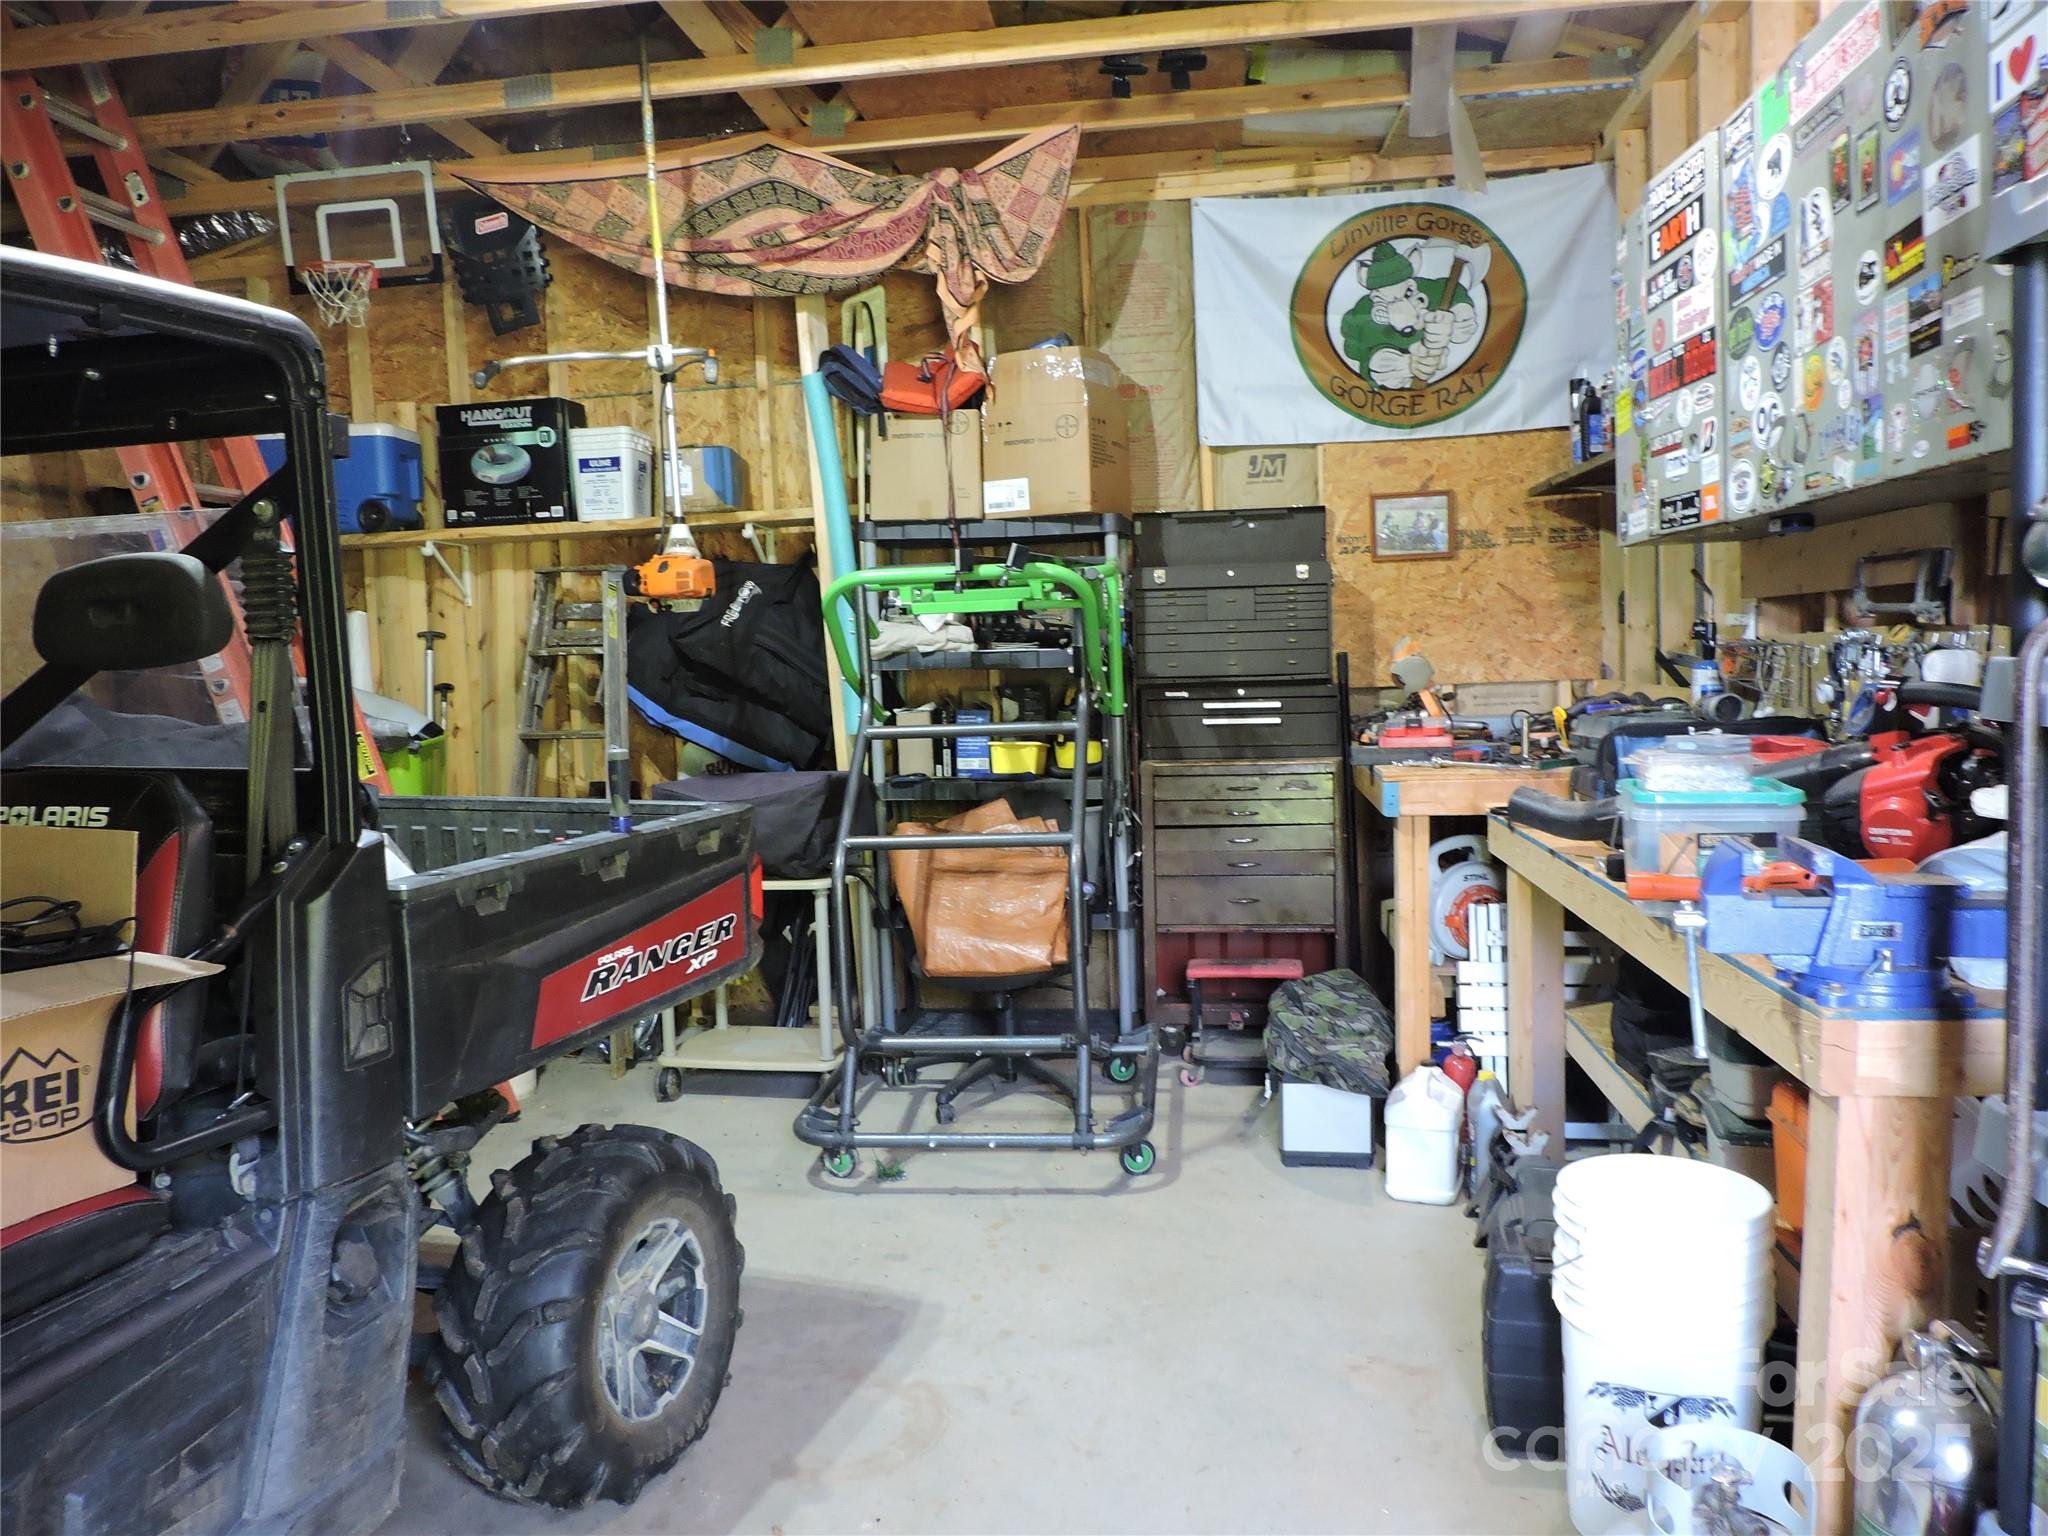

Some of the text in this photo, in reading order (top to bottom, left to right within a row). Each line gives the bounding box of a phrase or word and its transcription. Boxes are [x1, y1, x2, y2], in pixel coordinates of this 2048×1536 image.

[1329, 211, 1483, 260] Linville Gorge
[1330, 362, 1491, 417] GORGE RAT
[460, 406, 533, 422] HANGOUT
[1247, 453, 1287, 479] JM
[0, 806, 111, 827] POLARIS
[580, 913, 737, 1002] RANGER
[685, 949, 719, 974] XP
